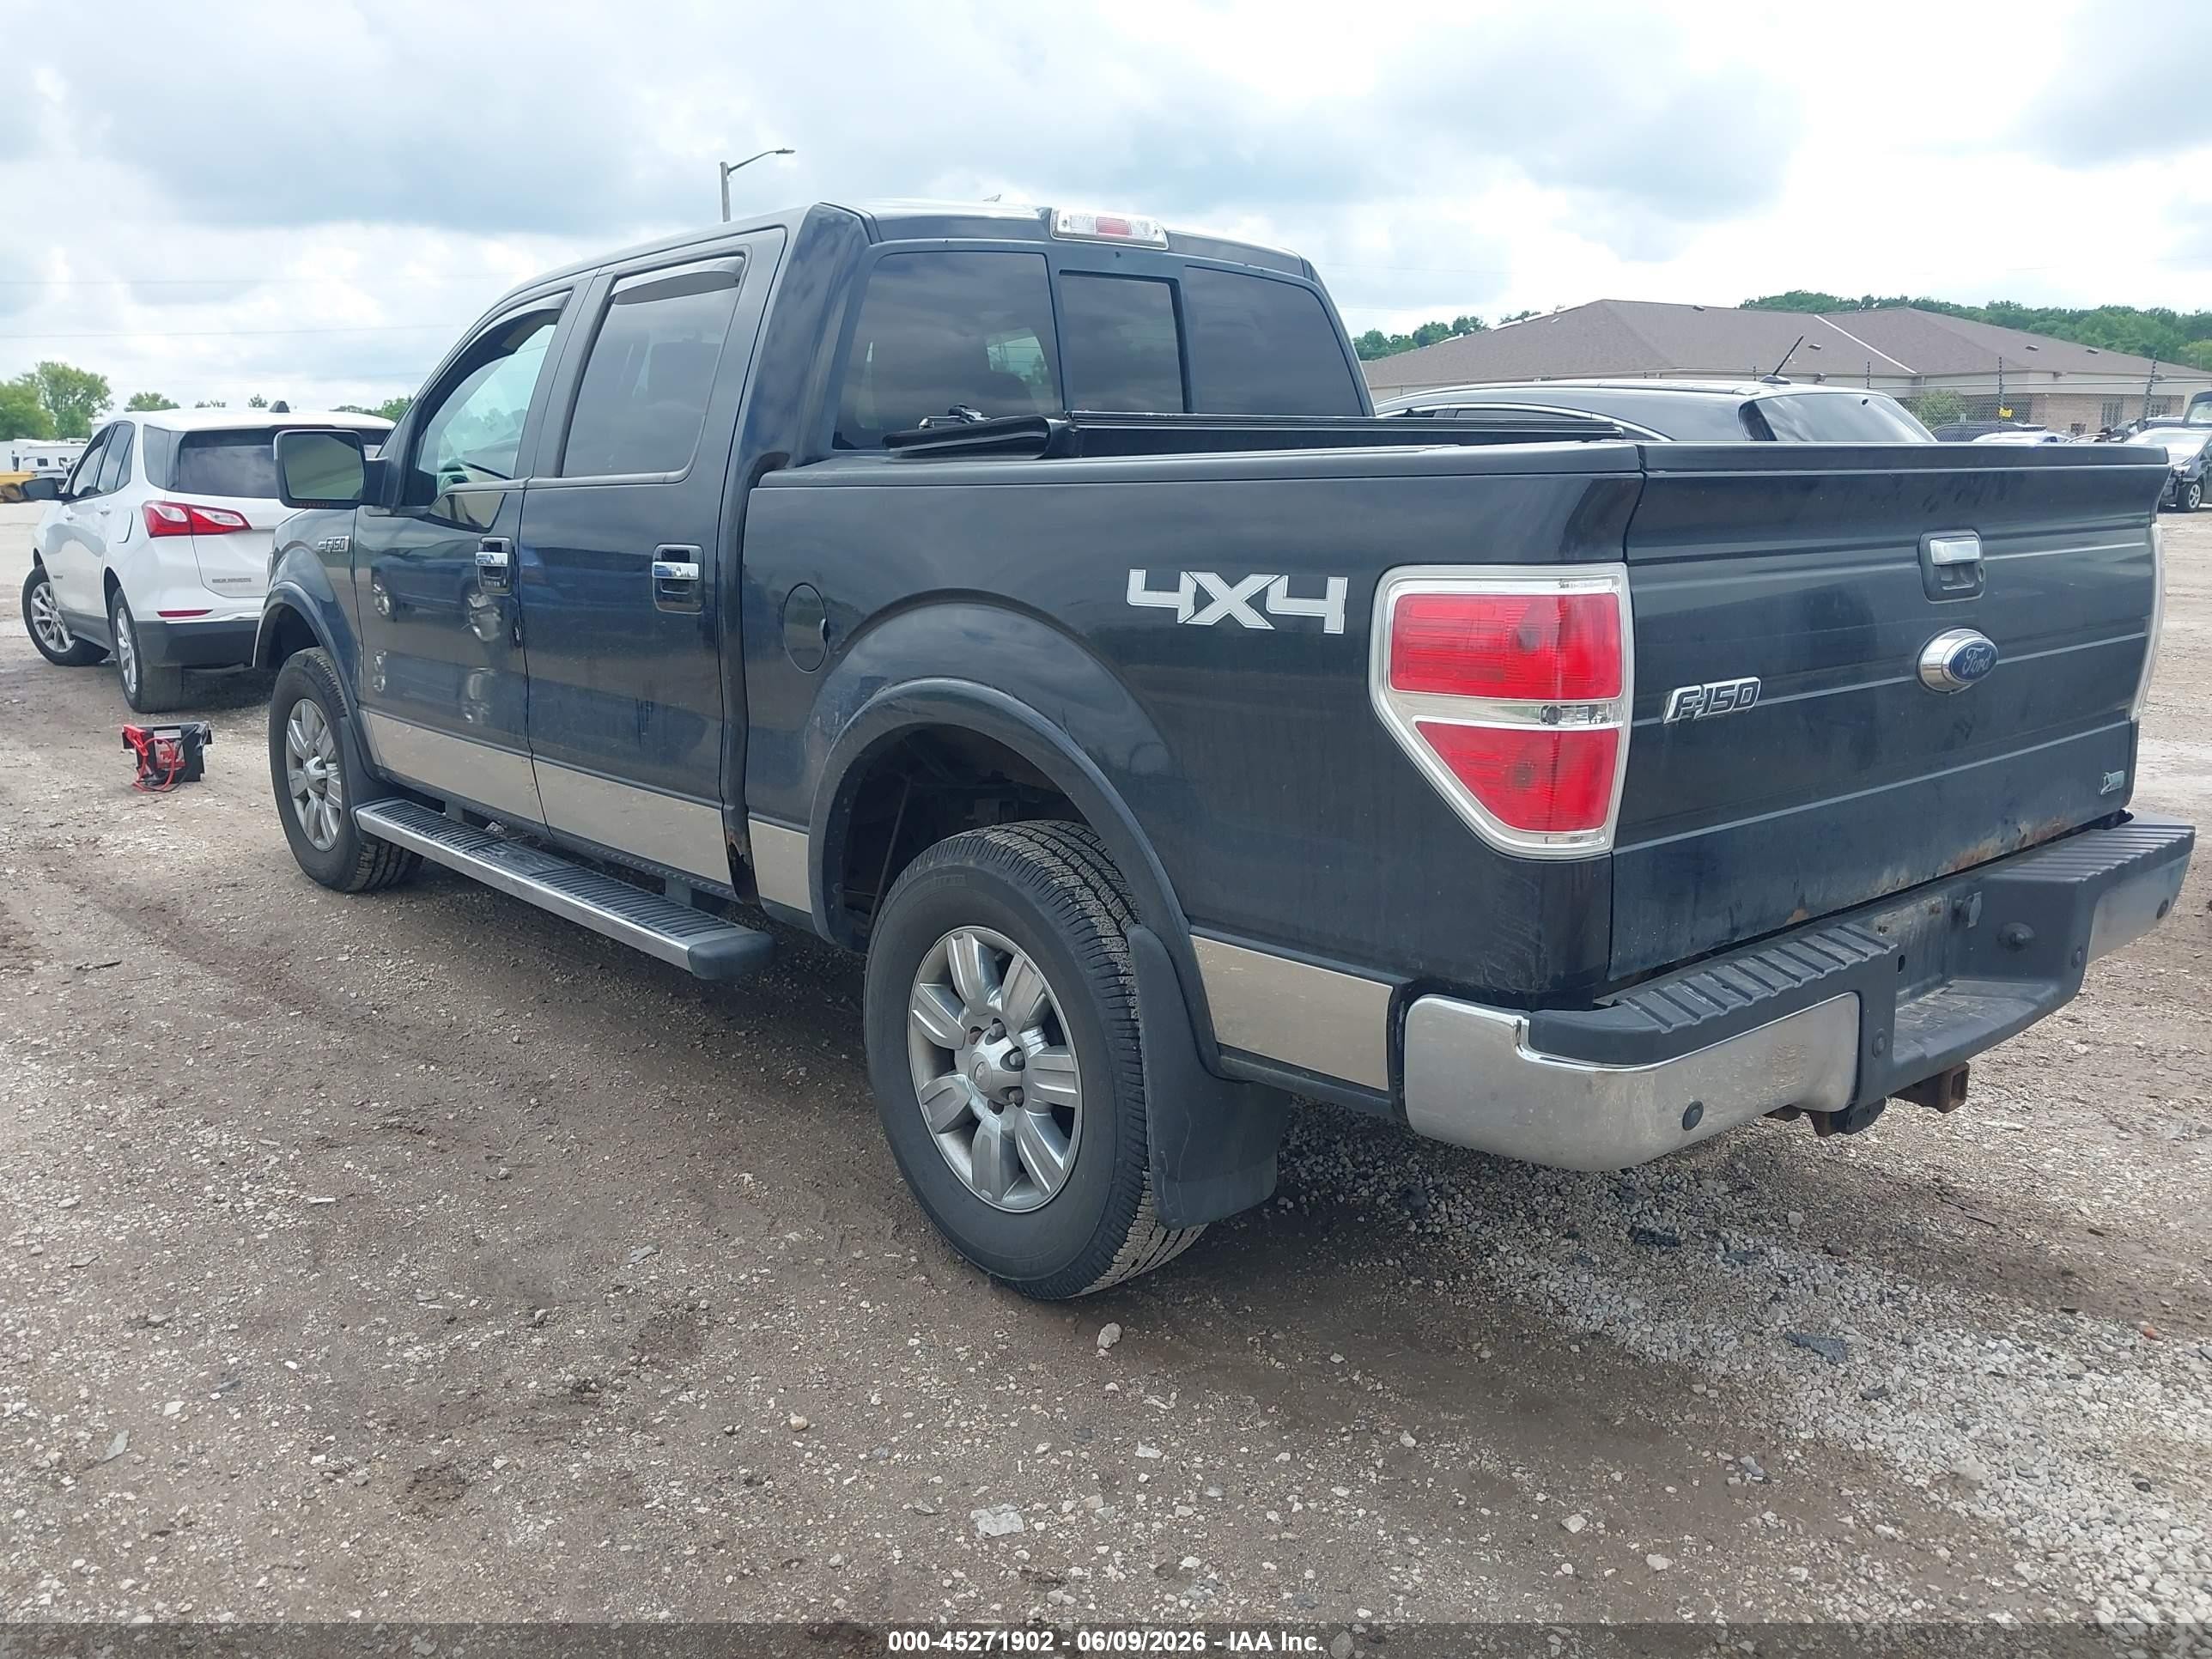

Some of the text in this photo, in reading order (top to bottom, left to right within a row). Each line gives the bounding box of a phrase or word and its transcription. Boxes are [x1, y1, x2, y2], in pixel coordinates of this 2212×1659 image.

[1127, 569, 1348, 634] 4X4
[1961, 647, 1992, 675] Ford
[1663, 677, 1761, 724] F-150
